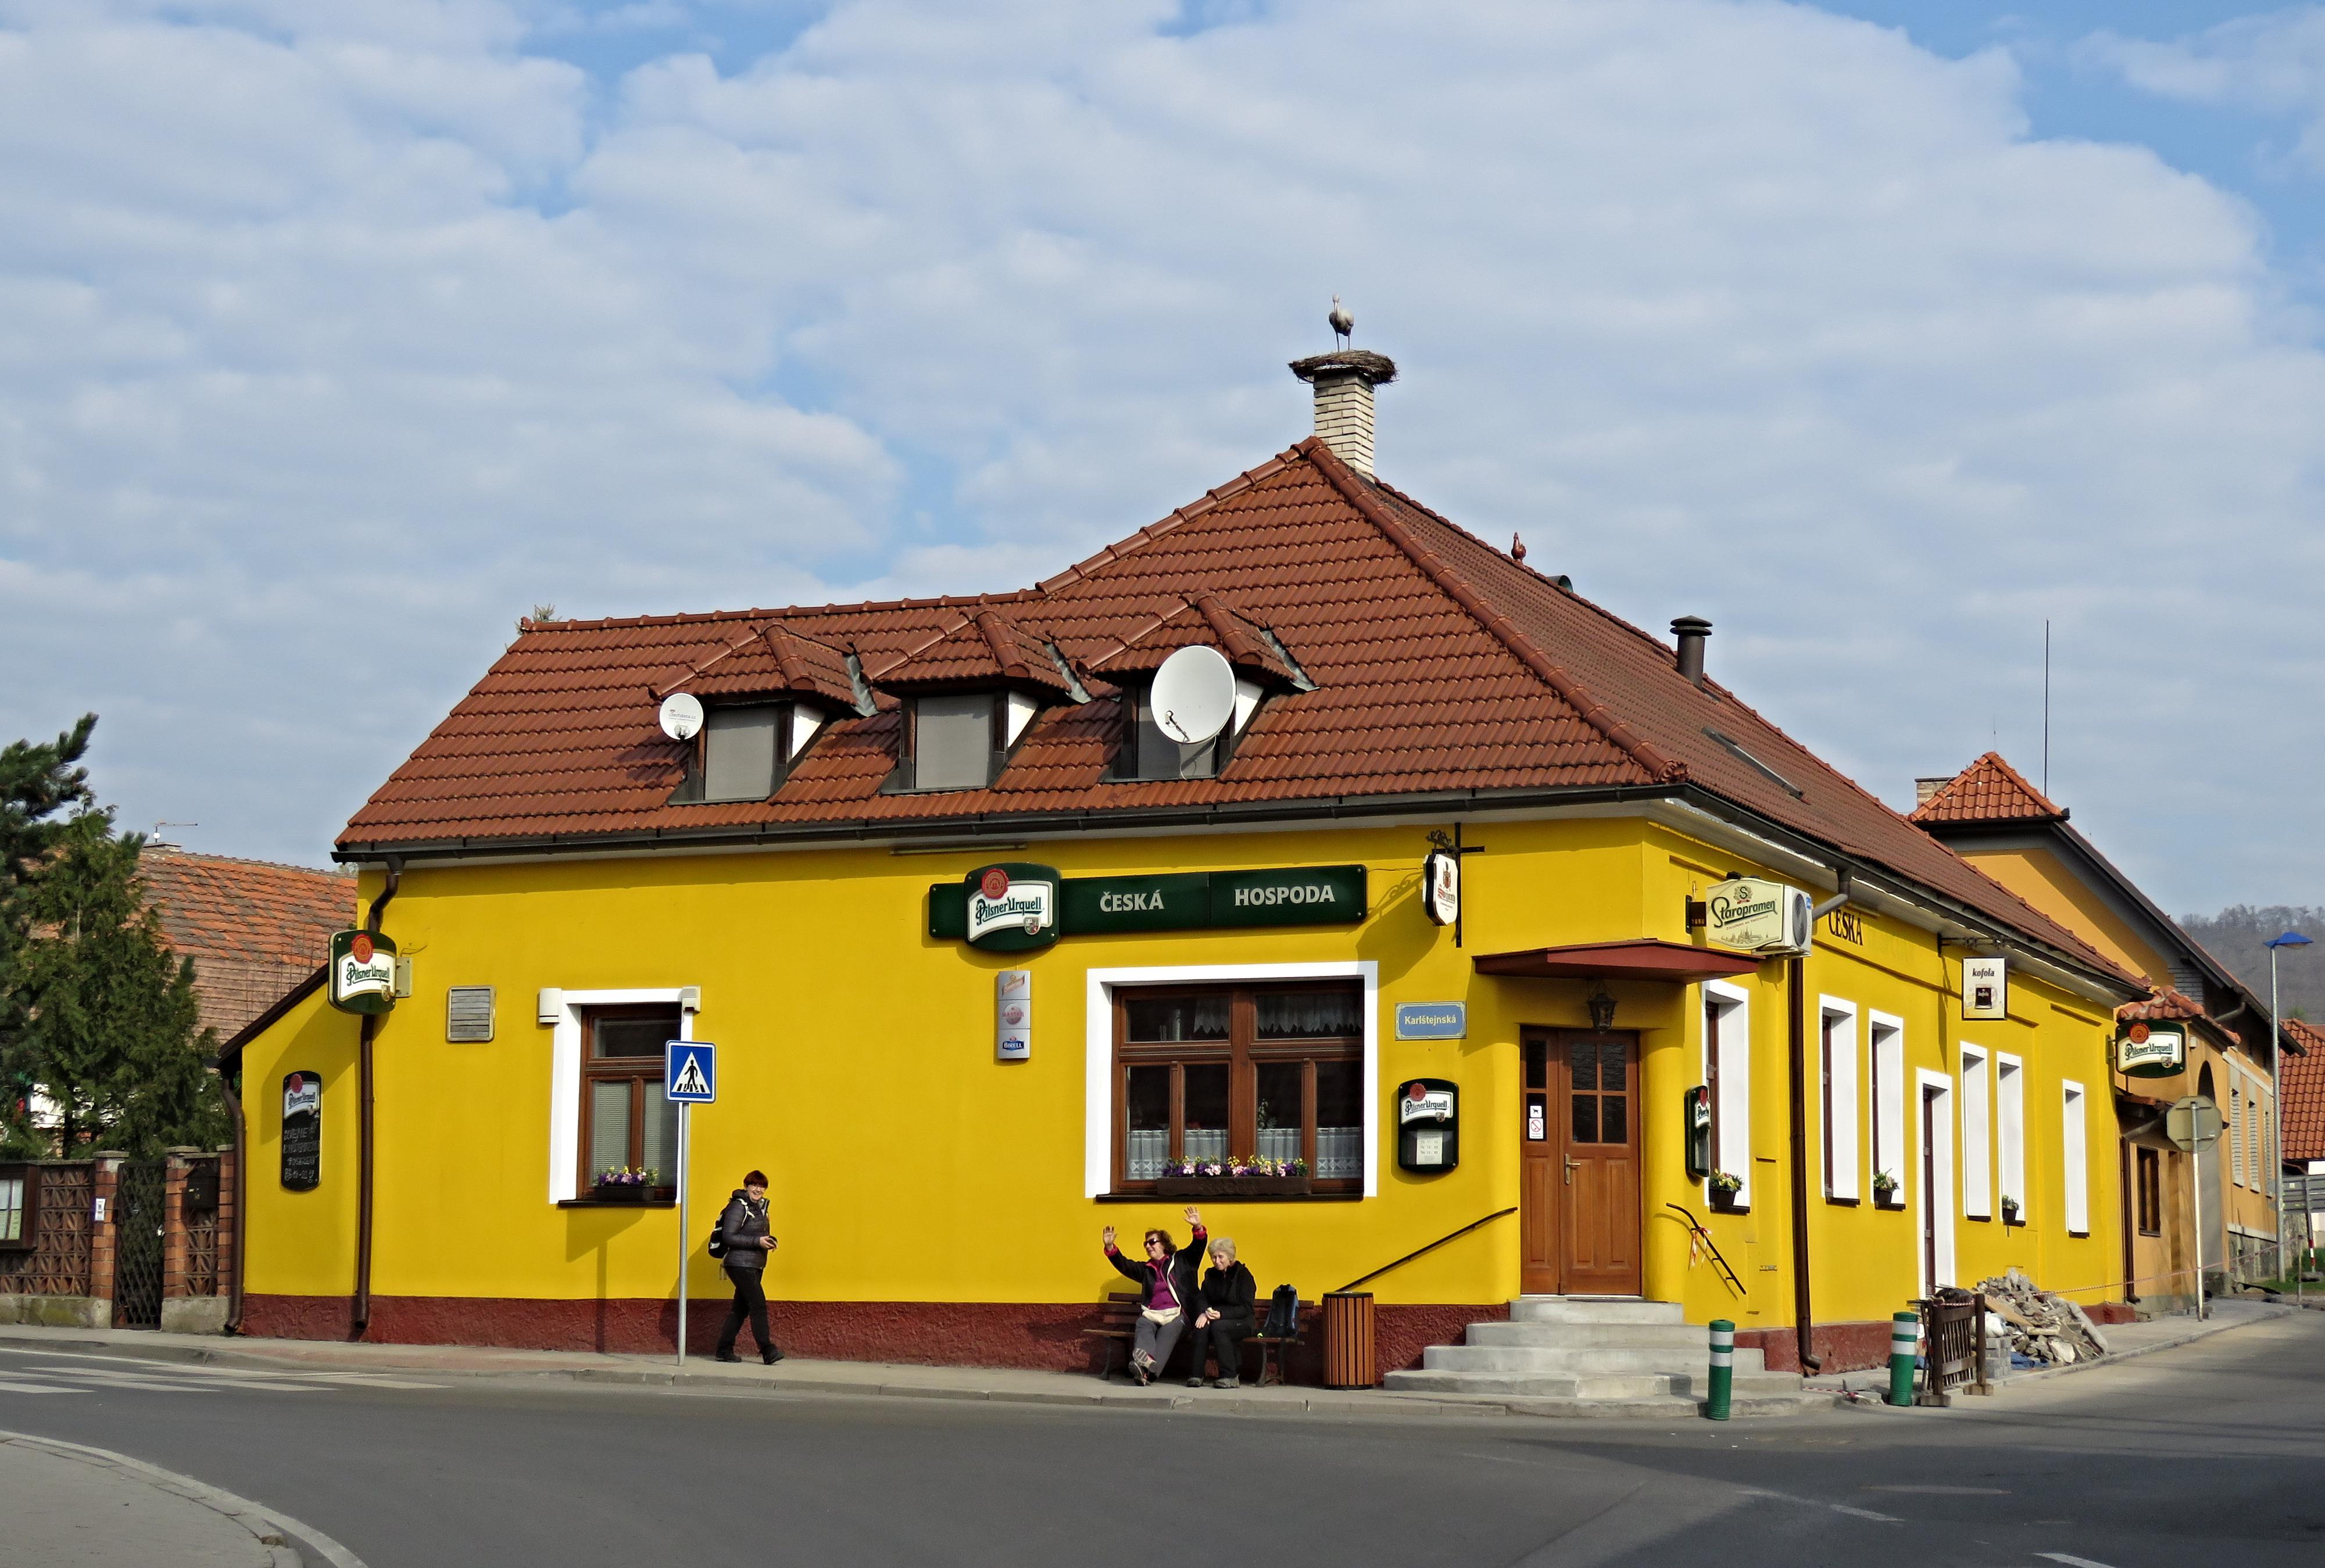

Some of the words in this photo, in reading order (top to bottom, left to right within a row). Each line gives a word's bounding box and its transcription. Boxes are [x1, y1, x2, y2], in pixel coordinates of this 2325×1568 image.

[1100, 889, 1164, 912] ČESKÁ
[1235, 885, 1336, 906] HOSPODA
[975, 898, 1008, 926] Pilsner
[1007, 897, 1042, 916] Urquell
[1711, 896, 1777, 928] Staropramen
[346, 962, 371, 986] Pilsner
[371, 964, 390, 983] Urquell
[1972, 968, 1995, 979] kofola
[1404, 1014, 1457, 1026] Karlštejnská
[2125, 1043, 2148, 1061] Pilsner
[2148, 1043, 2173, 1055] Urquell
[1405, 1100, 1426, 1116] Pilsner
[1425, 1100, 1447, 1111] Urquell
